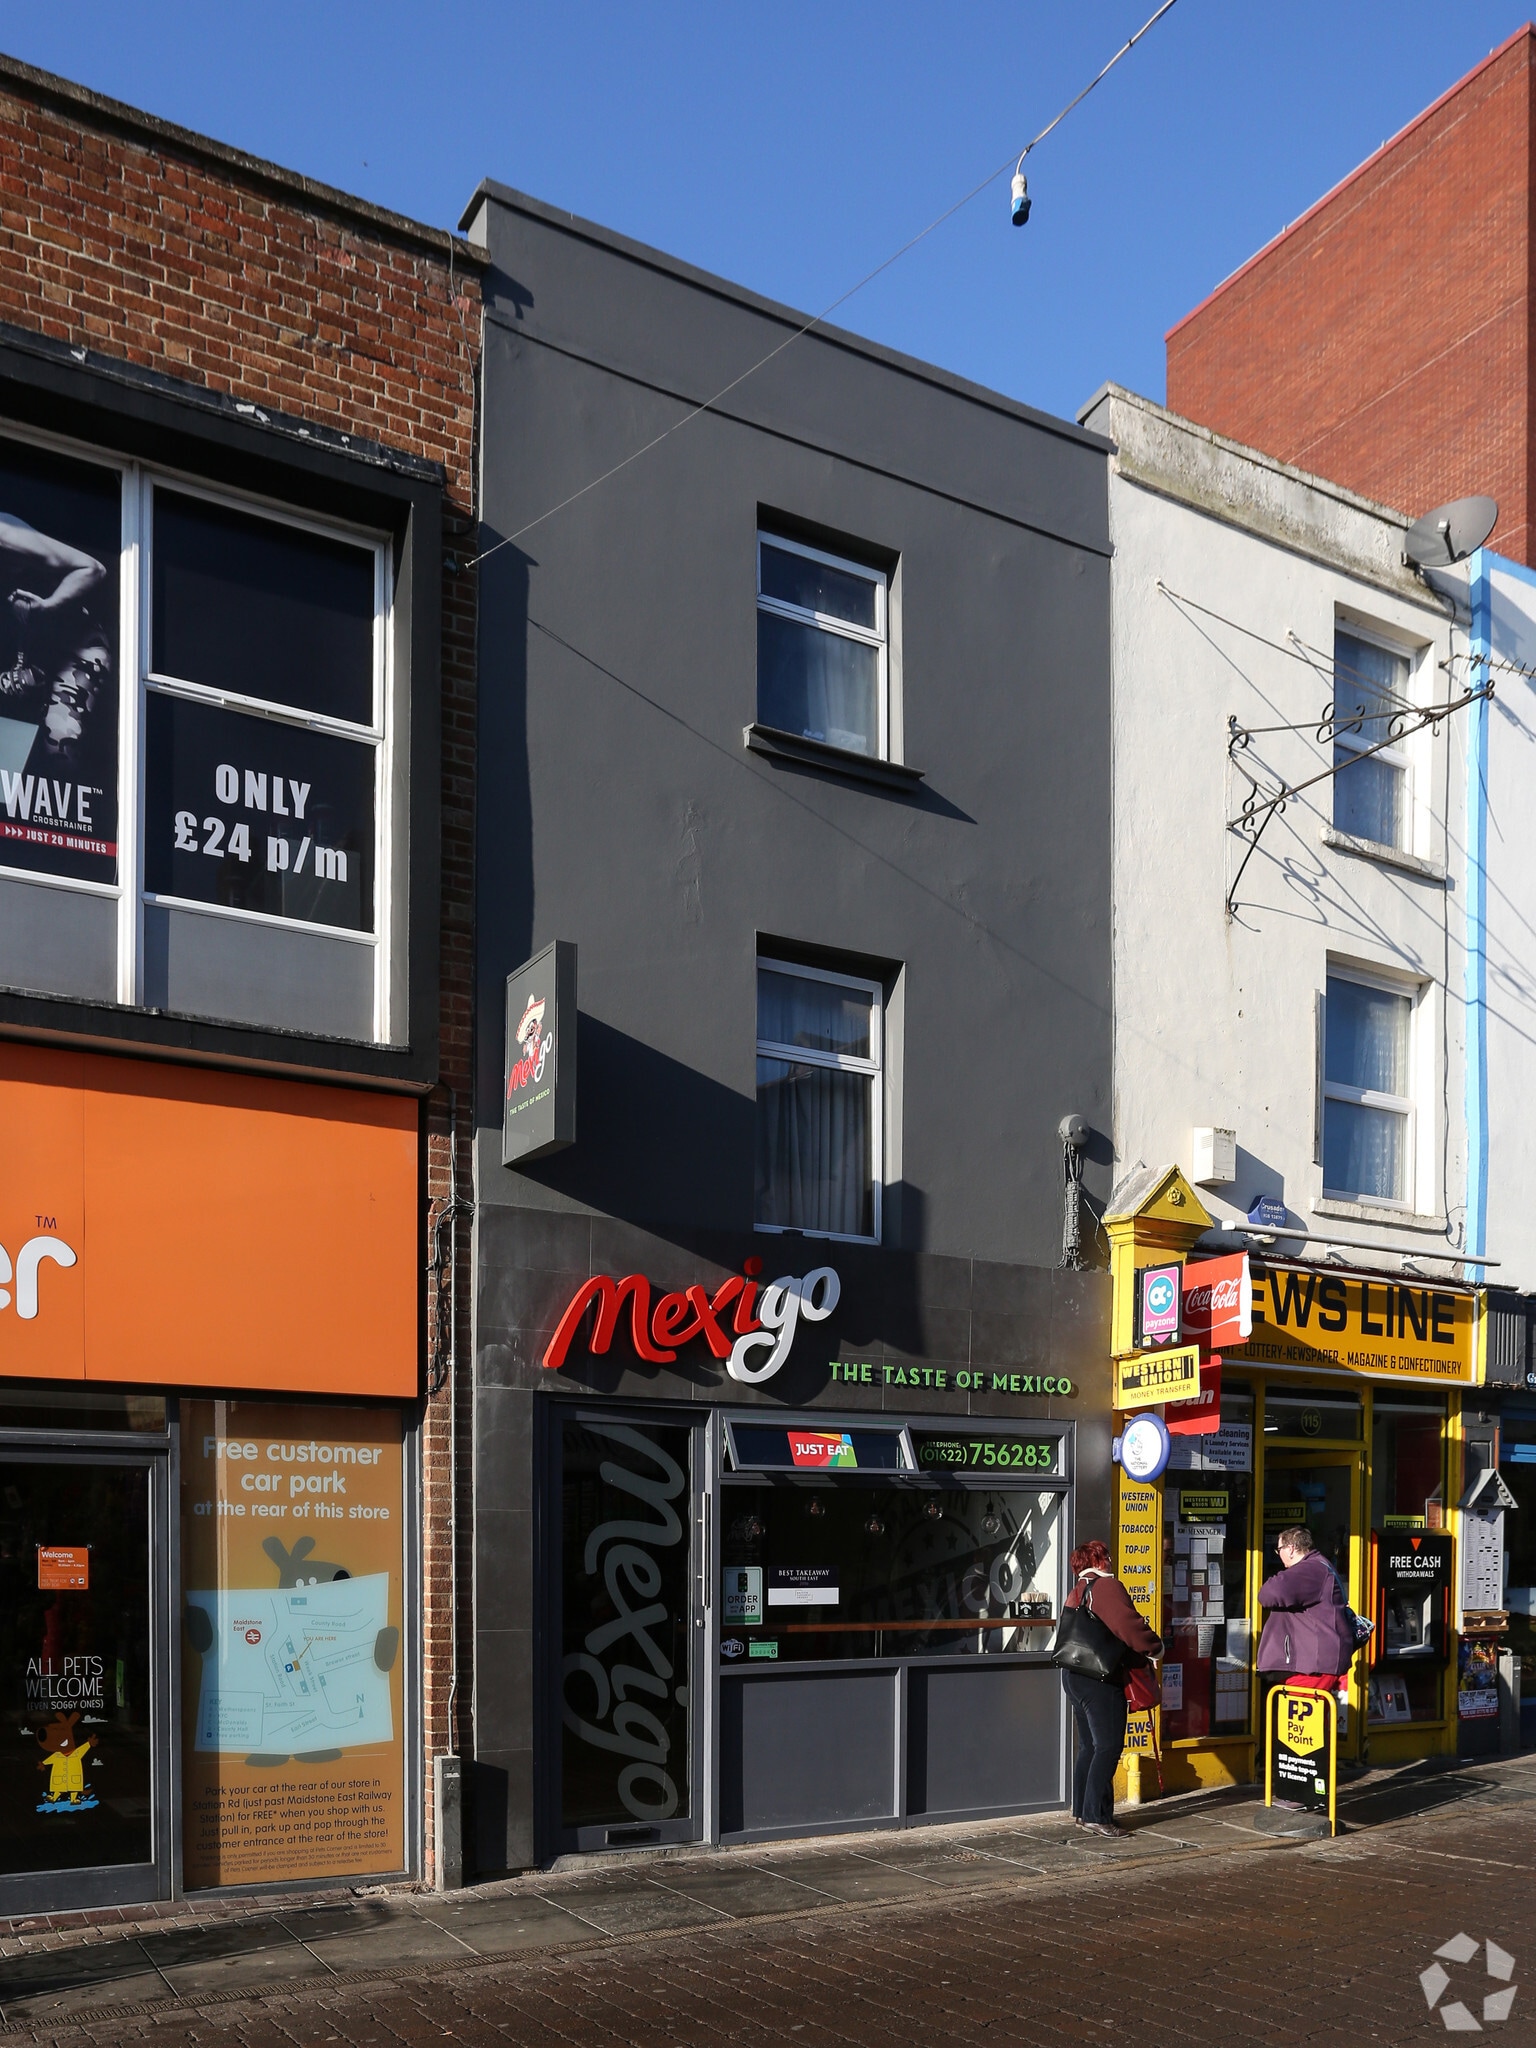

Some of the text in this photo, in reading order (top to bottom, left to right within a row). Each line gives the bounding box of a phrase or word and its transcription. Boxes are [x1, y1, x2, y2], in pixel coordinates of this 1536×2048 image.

[0, 768, 93, 824] WAVE
[215, 763, 311, 820] ONLY
[33, 815, 93, 832] CROSSTRAINER
[26, 829, 107, 853] JUST 20 MINUTES
[174, 810, 348, 882] £24 p/m
[507, 1031, 553, 1100] Mexigo
[509, 1106, 517, 1116] THE
[0, 1236, 77, 1319] r
[1250, 1267, 1456, 1345] EWS LINE
[542, 1255, 841, 1383] Mexigo
[1145, 1316, 1176, 1331] payzone
[1122, 1357, 1182, 1379] WESTERN
[1347, 1353, 1388, 1369] MAGAZINE
[1390, 1356, 1396, 1369] &
[1399, 1357, 1462, 1375] CONFECTIONERY
[829, 1361, 1073, 1395] THE TASTE OF MEXICO
[1140, 1368, 1182, 1387] UNION
[1130, 1383, 1191, 1400] MONEY TRANSFER
[1303, 1414, 1319, 1427] 115
[1219, 1429, 1250, 1440] cleaning
[203, 1436, 382, 1465] Free customer
[795, 1443, 849, 1456] JUST EAT
[919, 1442, 1051, 1467] (01622) 756283
[240, 1470, 347, 1498] car park
[1121, 1491, 1155, 1501] WESTERN
[193, 1499, 390, 1520] at the rear of this store
[1125, 1502, 1148, 1512] UNION
[1121, 1524, 1155, 1534] TOBACCO
[41, 1551, 74, 1559] Welcome
[1124, 1545, 1150, 1554] TOP-UP
[1390, 1555, 1441, 1568] FREE CASH
[778, 1569, 794, 1577] BEST
[1396, 1570, 1435, 1578] WITHDRAWALS
[1128, 1585, 1147, 1593] NEWS
[727, 1594, 758, 1604] ORDER
[1132, 1593, 1151, 1603] PERS
[738, 1604, 756, 1613] APP
[561, 1424, 690, 1820] Mexigo
[26, 1655, 104, 1677] ALL PETS
[25, 1676, 104, 1698] WELCOME
[27, 1698, 104, 1711] (EVEN SOGGY ONES)
[356, 1693, 365, 1703] N
[1127, 1721, 1151, 1734] EWS
[1287, 1721, 1304, 1735] Pay
[1287, 1732, 1314, 1746] Point
[1278, 1762, 1318, 1776] Mobile top-up
[1288, 1756, 1316, 1767] payments
[1279, 1770, 1308, 1782] TV licence
[205, 1785, 226, 1796] Park
[229, 1787, 249, 1796] your
[270, 1784, 279, 1792] at
[281, 1782, 296, 1791] the
[298, 1782, 317, 1791] rear
[320, 1780, 329, 1789] of
[331, 1781, 346, 1789] our
[348, 1779, 370, 1788] store
[372, 1778, 380, 1787] in
[192, 1790, 392, 1810] Station Rd (just past Maidstone East Railway
[200, 1812, 235, 1823] Station)
[237, 1812, 250, 1820] for
[280, 1808, 306, 1818] when
[308, 1809, 325, 1818] you
[327, 1806, 349, 1816] shop
[351, 1804, 370, 1813] with
[372, 1805, 385, 1813] us.
[201, 1816, 385, 1837] Just pull in, park up and pop through the
[197, 1828, 389, 1851] customer entrance at the rear of the store!
